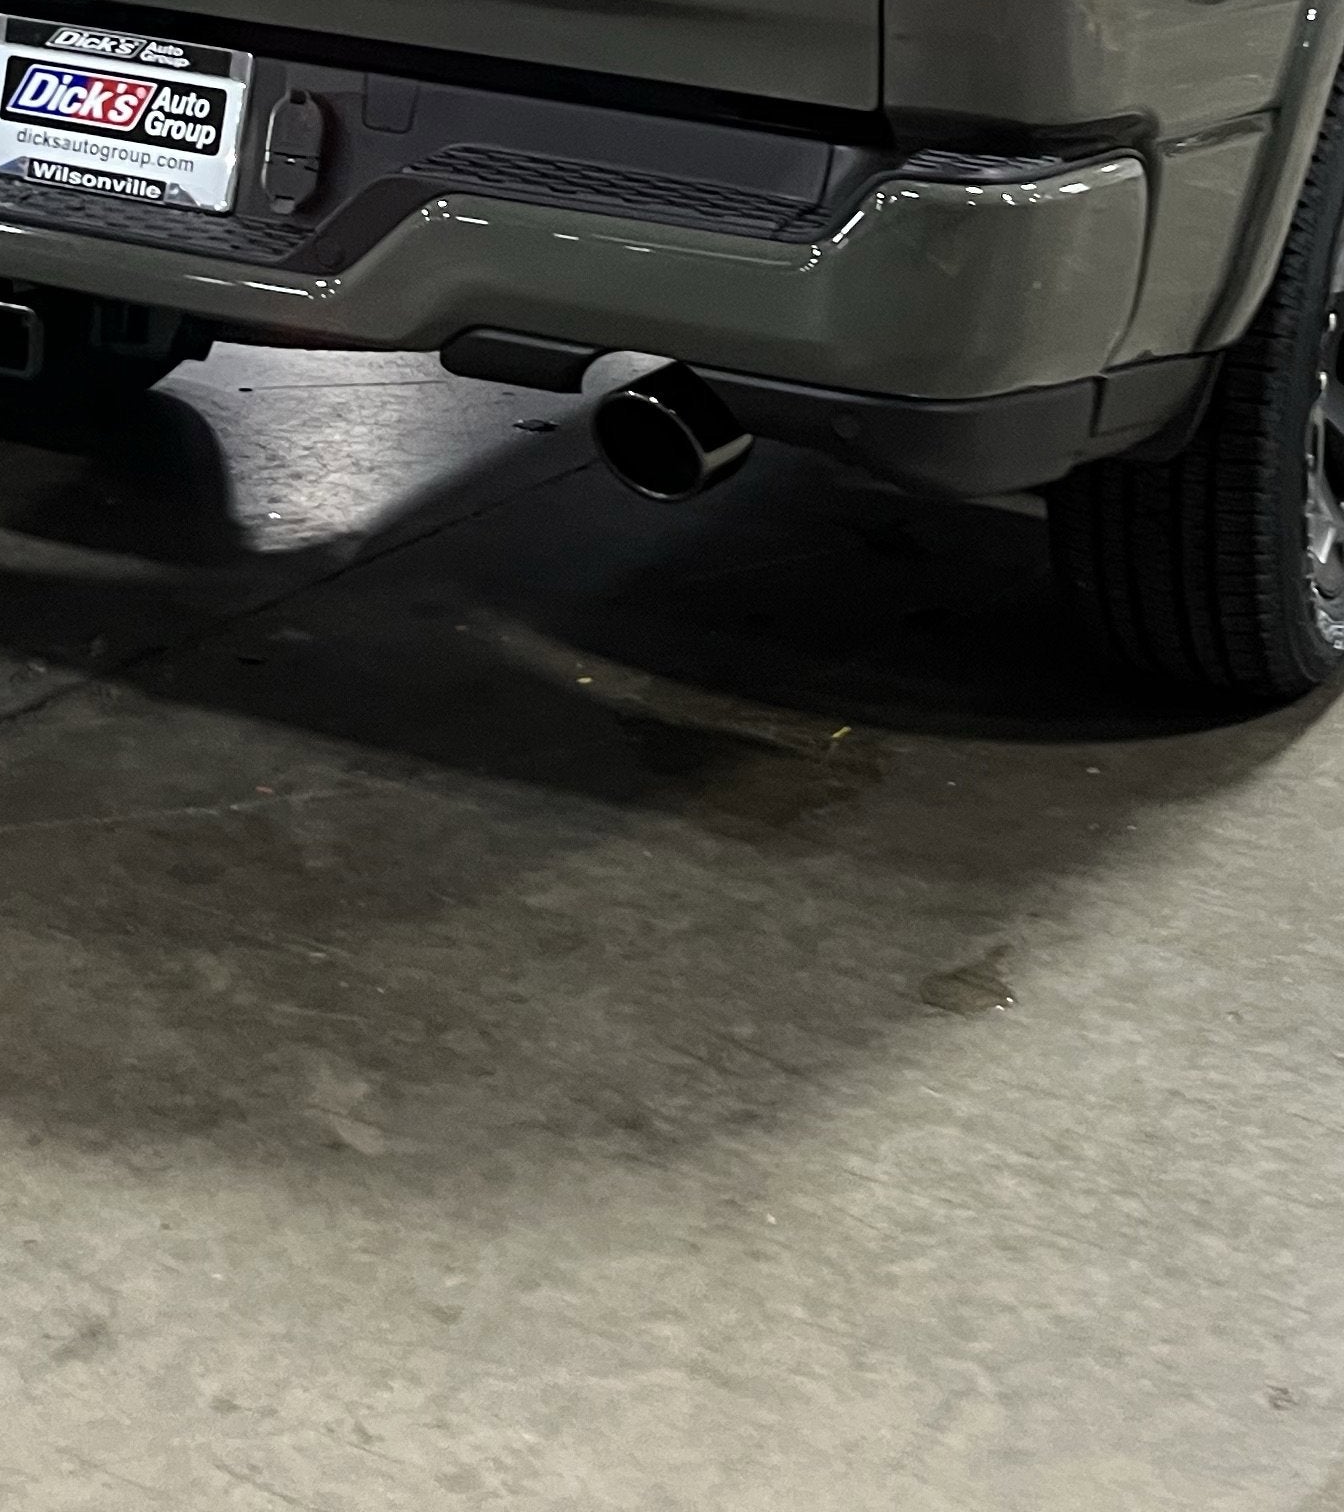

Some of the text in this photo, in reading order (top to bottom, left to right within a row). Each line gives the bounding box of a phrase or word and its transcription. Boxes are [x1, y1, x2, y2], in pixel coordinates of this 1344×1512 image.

[53, 29, 185, 58] Dick's Auto
[140, 51, 191, 68] Group
[17, 70, 210, 124] Dick's Auto
[144, 111, 217, 149] Group
[16, 127, 195, 173] dicksautogroup.com
[32, 160, 162, 200] Wilsonville
